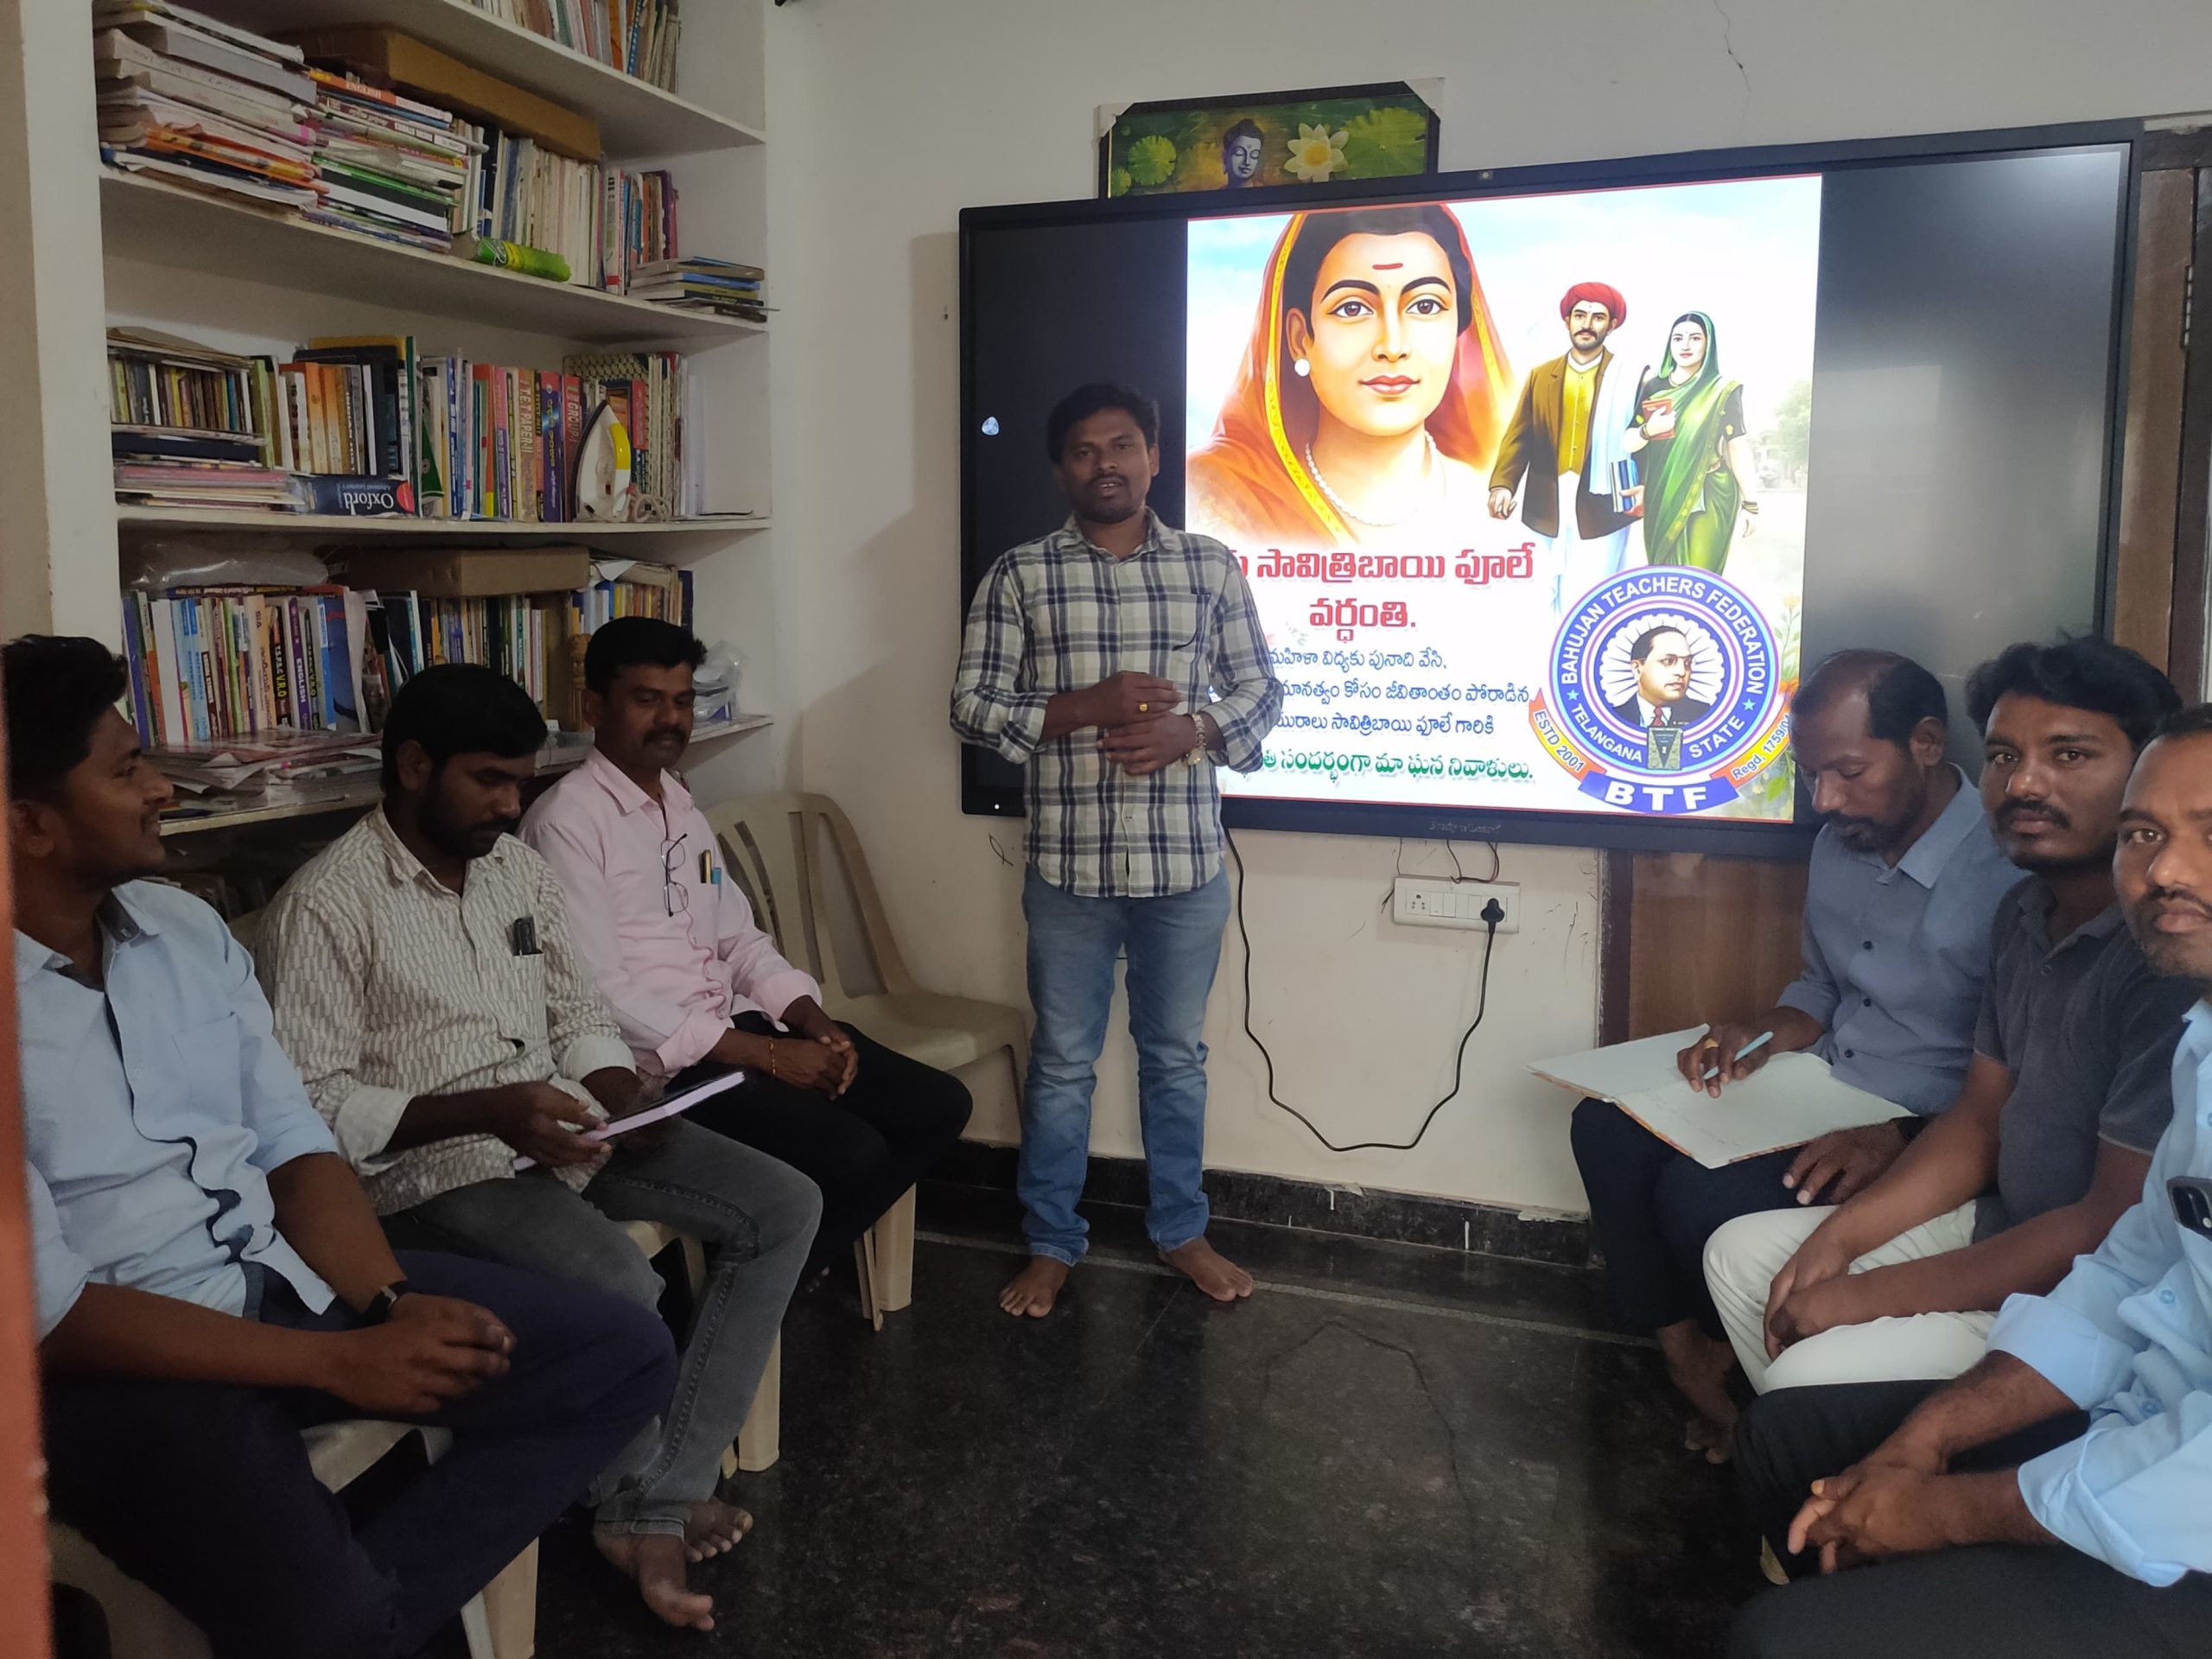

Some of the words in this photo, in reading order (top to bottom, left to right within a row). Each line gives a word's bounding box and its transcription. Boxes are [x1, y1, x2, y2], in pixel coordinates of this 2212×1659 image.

[343, 492, 395, 510] Oxford
[1257, 549, 1445, 583] సావిత్రిబాయి
[1455, 543, 1536, 585] పూలే
[1310, 598, 1416, 643] వర్ధంతి.
[1560, 606, 1607, 685] BAHUJAN
[1601, 575, 1706, 609] TEACHERS
[1705, 592, 1766, 696] FEDERATION
[296, 657, 307, 703] ENGLISH
[1322, 649, 1366, 673] విద్యకు
[1369, 651, 1415, 670] పునాది
[276, 673, 287, 697] V.R.O
[1344, 677, 1382, 700] కోసం
[1385, 681, 1463, 702] జీవితాంతం
[1465, 682, 1530, 703] పోరాడిన
[1332, 713, 1413, 736] సావిత్రిబాయి
[1415, 712, 1453, 737] పూలే
[1455, 715, 1496, 734] గారికి
[1534, 710, 1560, 747] ESTD
[1555, 745, 1586, 772] 2001
[1570, 702, 1643, 764] TELANGANA
[1688, 715, 1745, 759] STATE
[1281, 748, 1371, 783] సందర్భంగా
[1375, 753, 1404, 772] మా
[1408, 754, 1444, 777] ఘన
